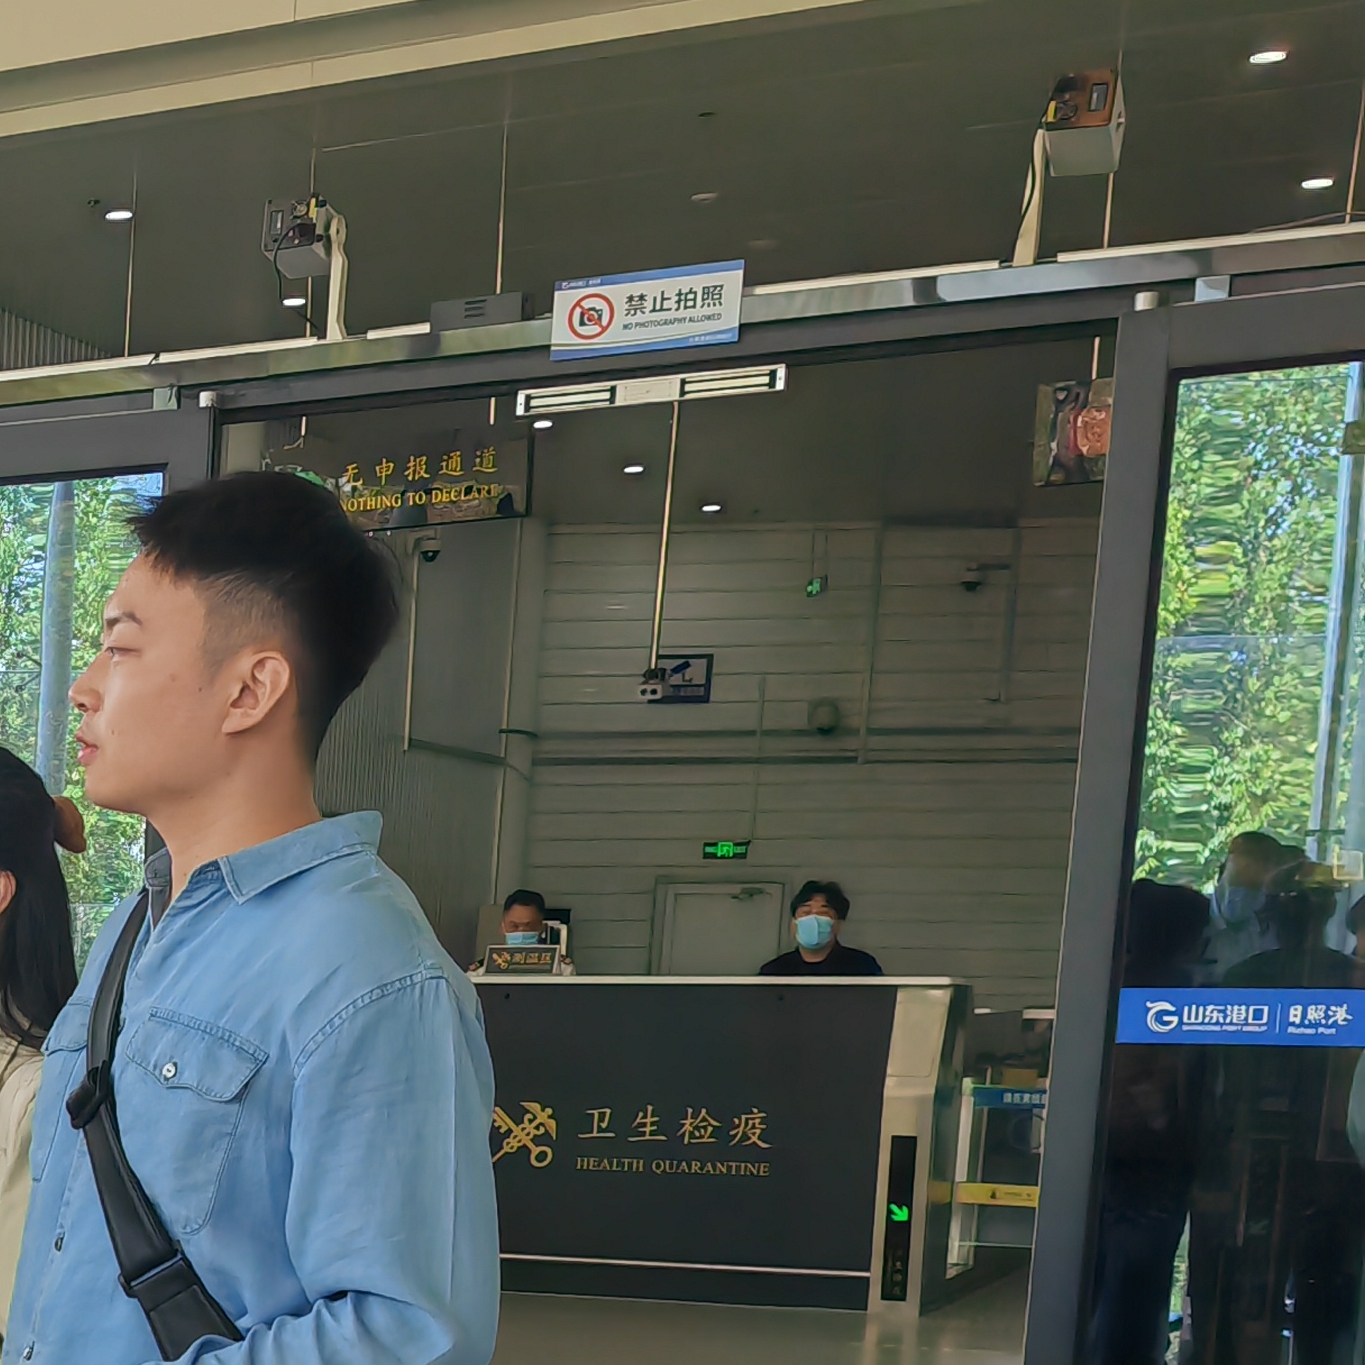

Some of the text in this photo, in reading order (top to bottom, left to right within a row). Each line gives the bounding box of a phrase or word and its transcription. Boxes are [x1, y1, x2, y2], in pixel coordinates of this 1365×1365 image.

[624, 284, 725, 318] 禁止拍照
[622, 312, 723, 331] NO PHOTOGRAPHY ALLOWED
[341, 446, 499, 487] 无申报通道
[340, 493, 402, 513] NOTHING
[407, 491, 426, 506] TO
[1182, 1003, 1354, 1026] 山东港口 日照港
[577, 1104, 774, 1149] 卫生检疫
[575, 1156, 770, 1177] HEALTH QUARANTINE
